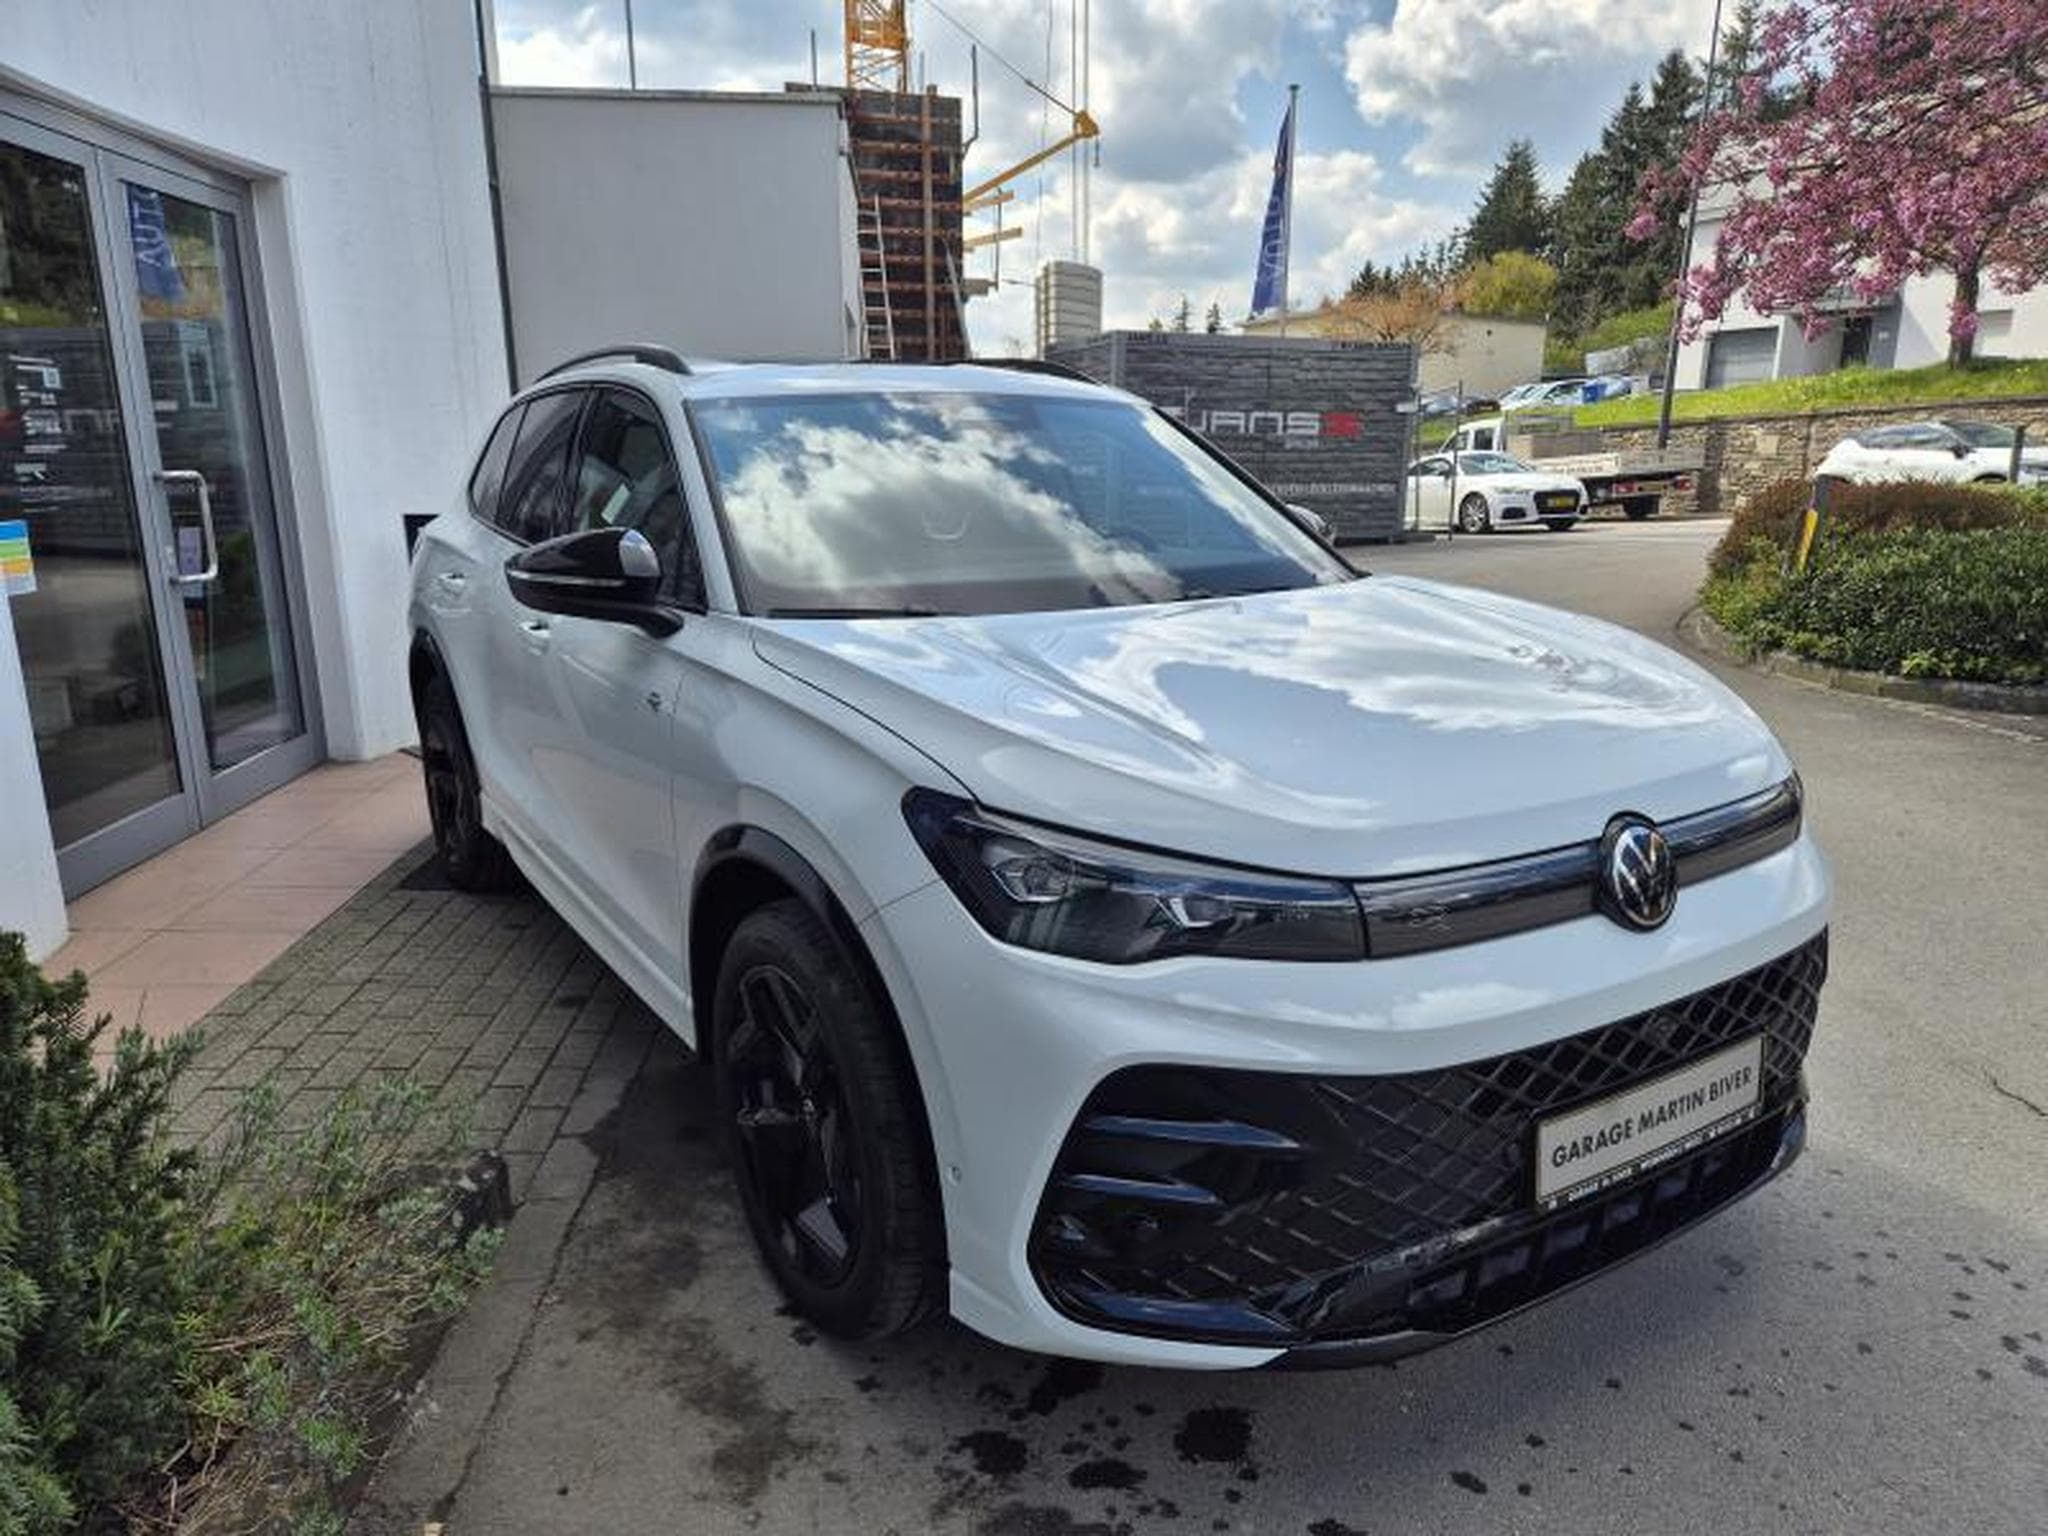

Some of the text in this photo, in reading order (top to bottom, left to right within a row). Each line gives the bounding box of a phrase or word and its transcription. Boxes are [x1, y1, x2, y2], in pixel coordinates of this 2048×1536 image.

[1551, 1114, 1633, 1168] GARAGE
[1637, 1087, 1704, 1136] MARTIN
[1709, 1066, 1752, 1102] BIVER
